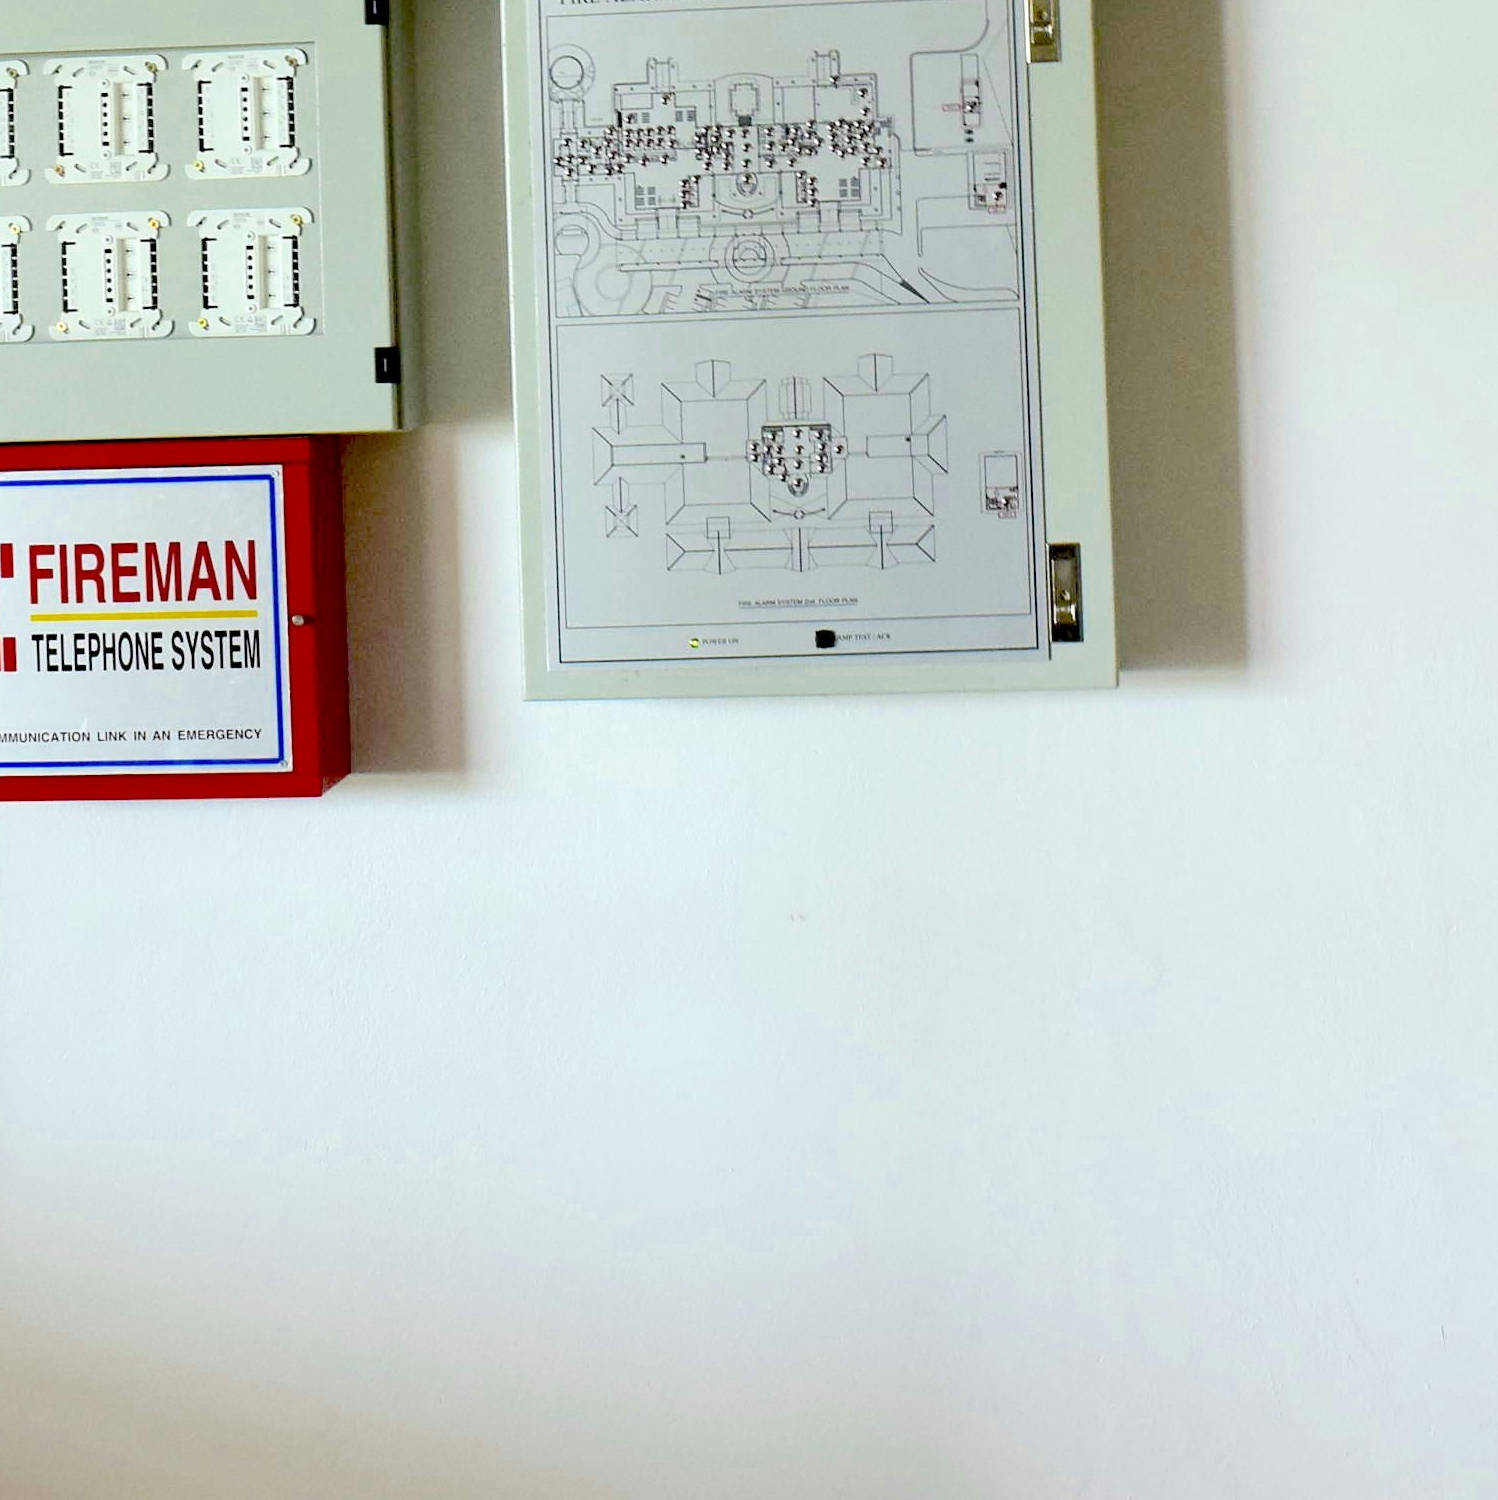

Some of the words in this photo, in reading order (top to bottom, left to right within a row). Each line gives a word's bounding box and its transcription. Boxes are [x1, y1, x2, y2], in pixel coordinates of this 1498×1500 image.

[29, 540, 258, 604] FIREMAN
[32, 632, 164, 672] TELEPHONE
[172, 629, 261, 670] SYSTEM
[98, 731, 127, 742] LINK
[134, 730, 147, 741] IN
[153, 730, 171, 741] AN
[178, 729, 263, 740] EMERGENCY
